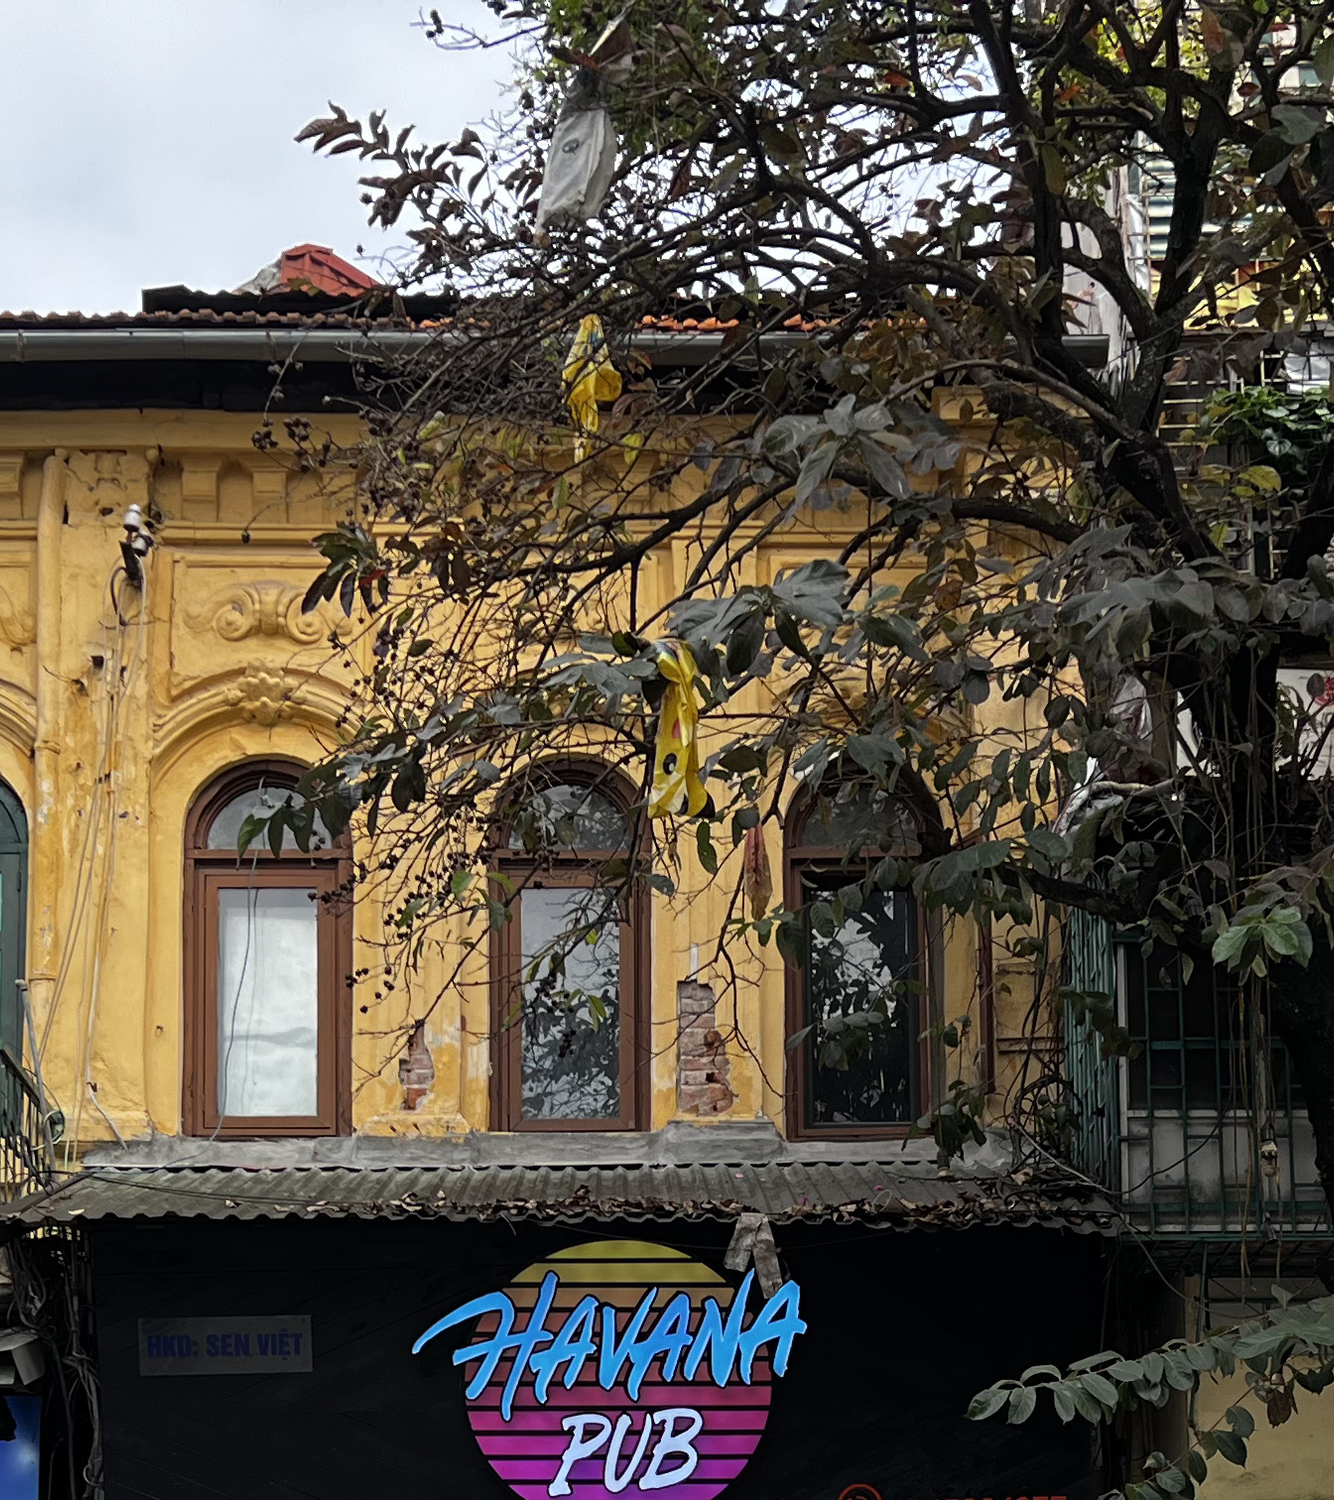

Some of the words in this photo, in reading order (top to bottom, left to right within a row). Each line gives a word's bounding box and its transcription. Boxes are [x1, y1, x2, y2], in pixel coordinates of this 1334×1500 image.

[146, 1333, 198, 1359] HKD:
[205, 1332, 250, 1358] SEN
[257, 1328, 303, 1360] VIỆT
[412, 1267, 808, 1422] HAVANA
[548, 1407, 703, 1497] PUB
